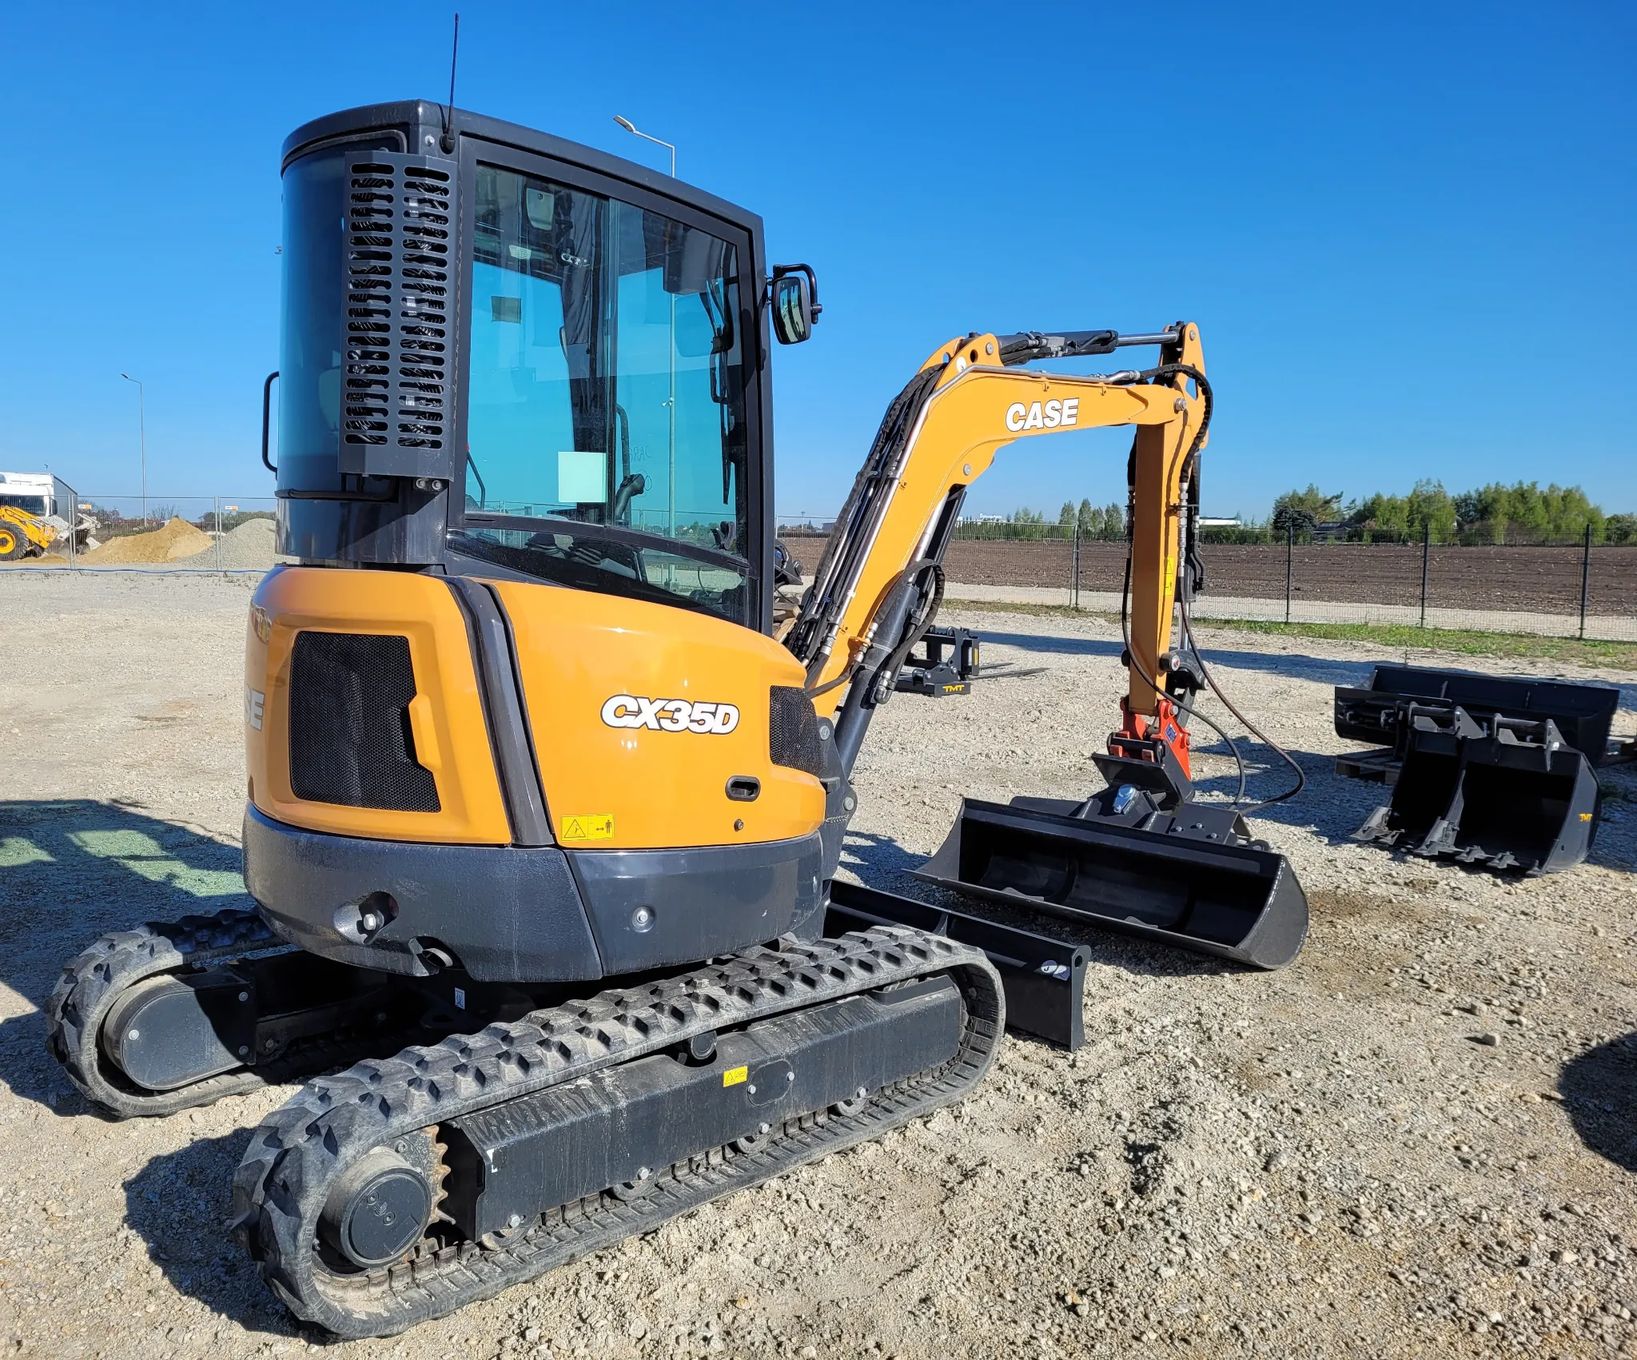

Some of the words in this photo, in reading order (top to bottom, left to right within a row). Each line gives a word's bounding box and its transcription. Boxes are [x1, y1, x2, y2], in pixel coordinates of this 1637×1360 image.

[1005, 397, 1080, 432] CASE
[942, 684, 965, 693] TMT
[600, 693, 741, 735] CX35D
